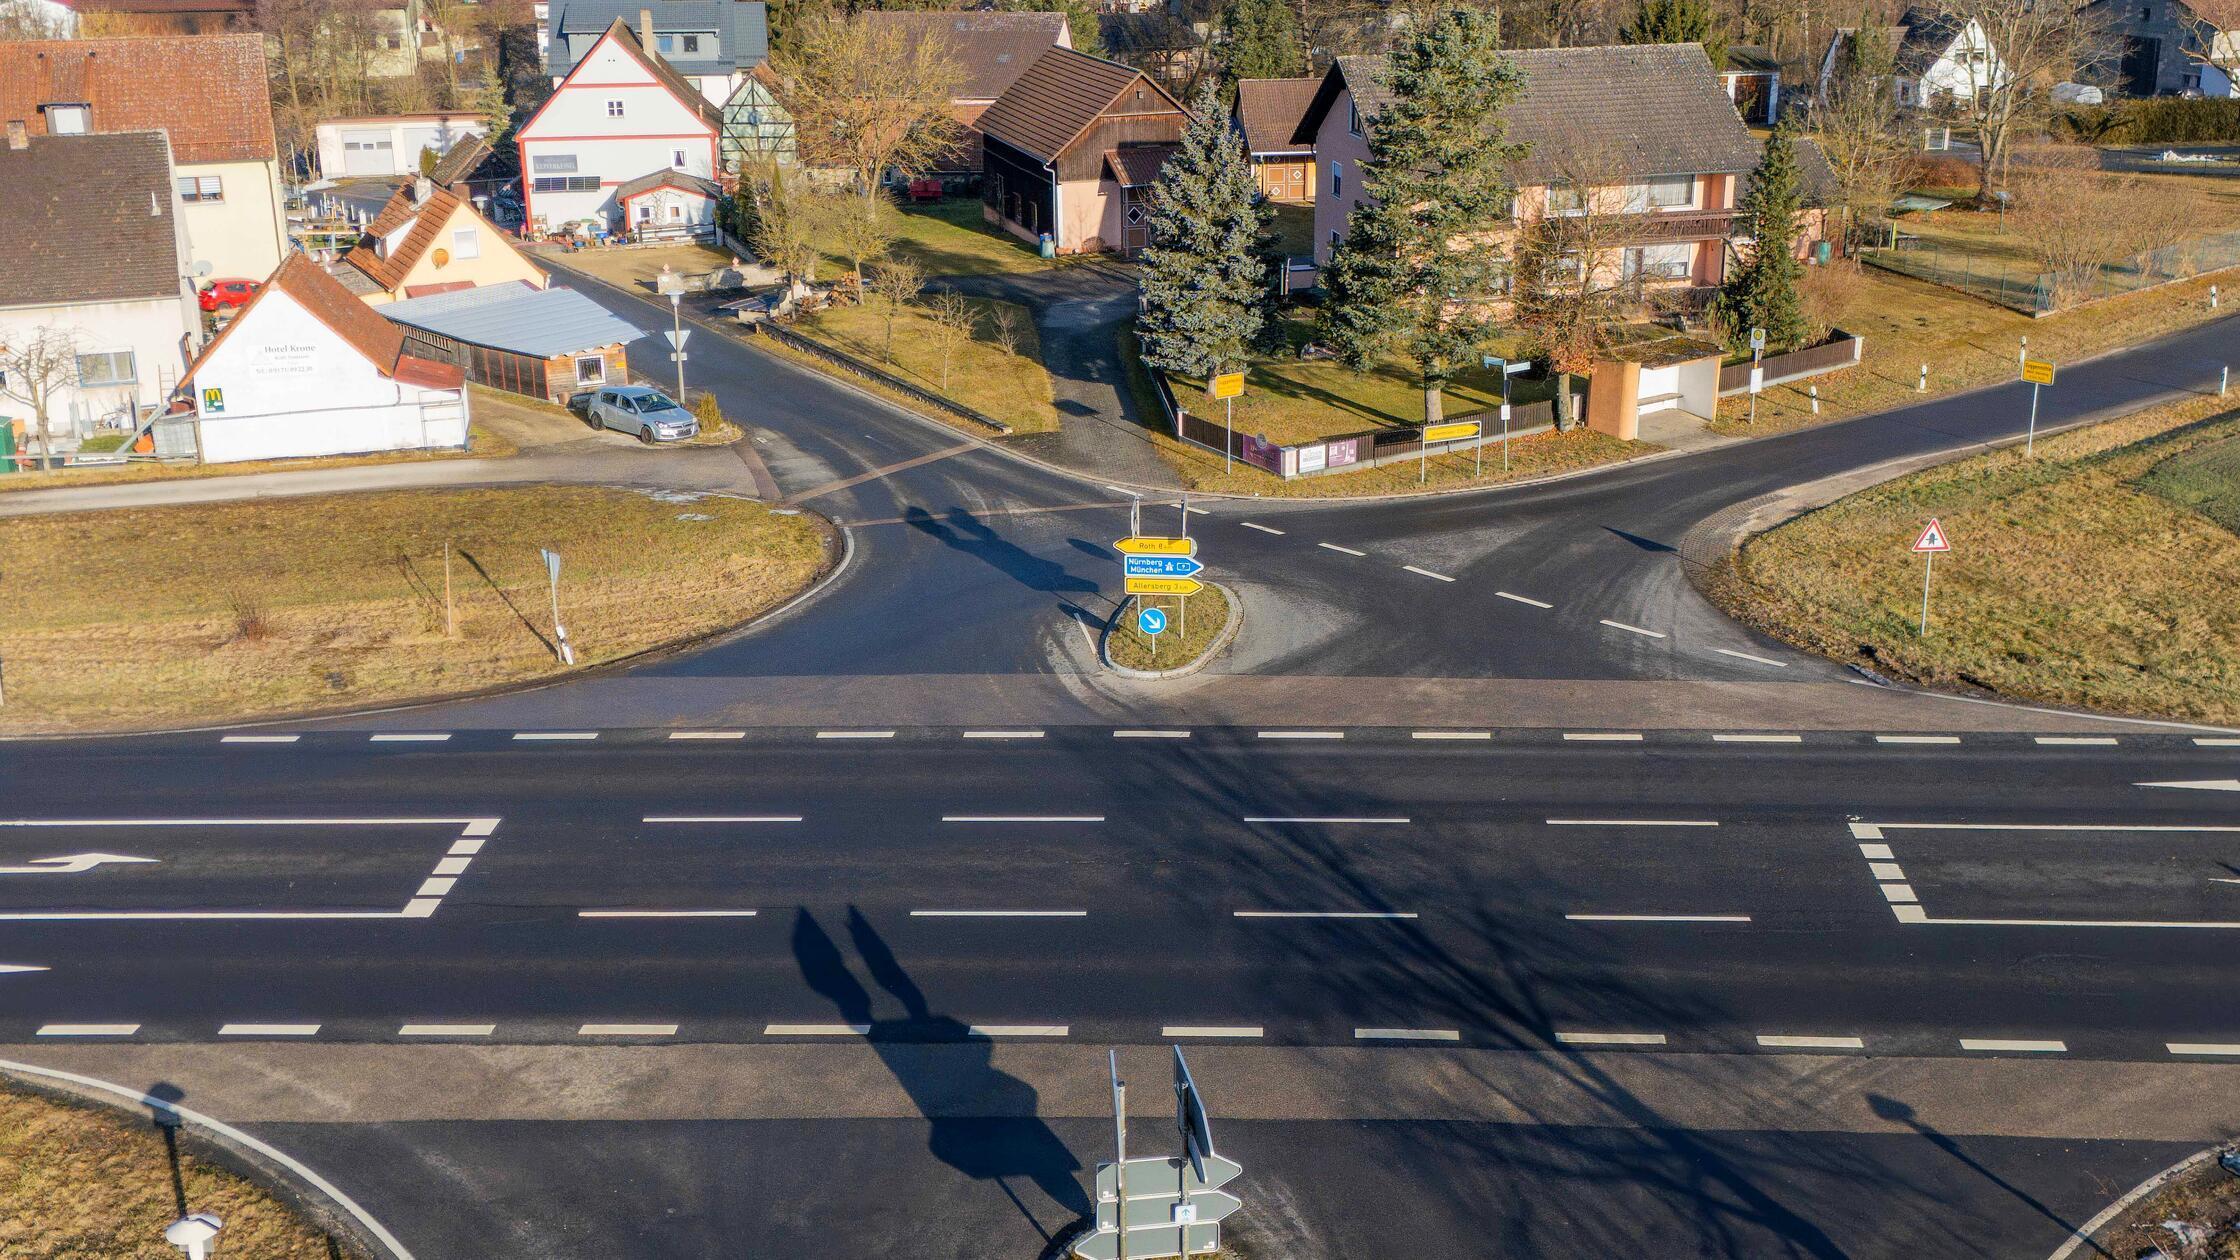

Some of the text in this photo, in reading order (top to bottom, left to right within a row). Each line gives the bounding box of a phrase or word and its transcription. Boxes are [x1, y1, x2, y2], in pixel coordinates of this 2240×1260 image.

[264, 344, 316, 353] Hotel Krone
[1128, 558, 1162, 567] Nürnberg
[1133, 582, 1171, 591] Allersberg
